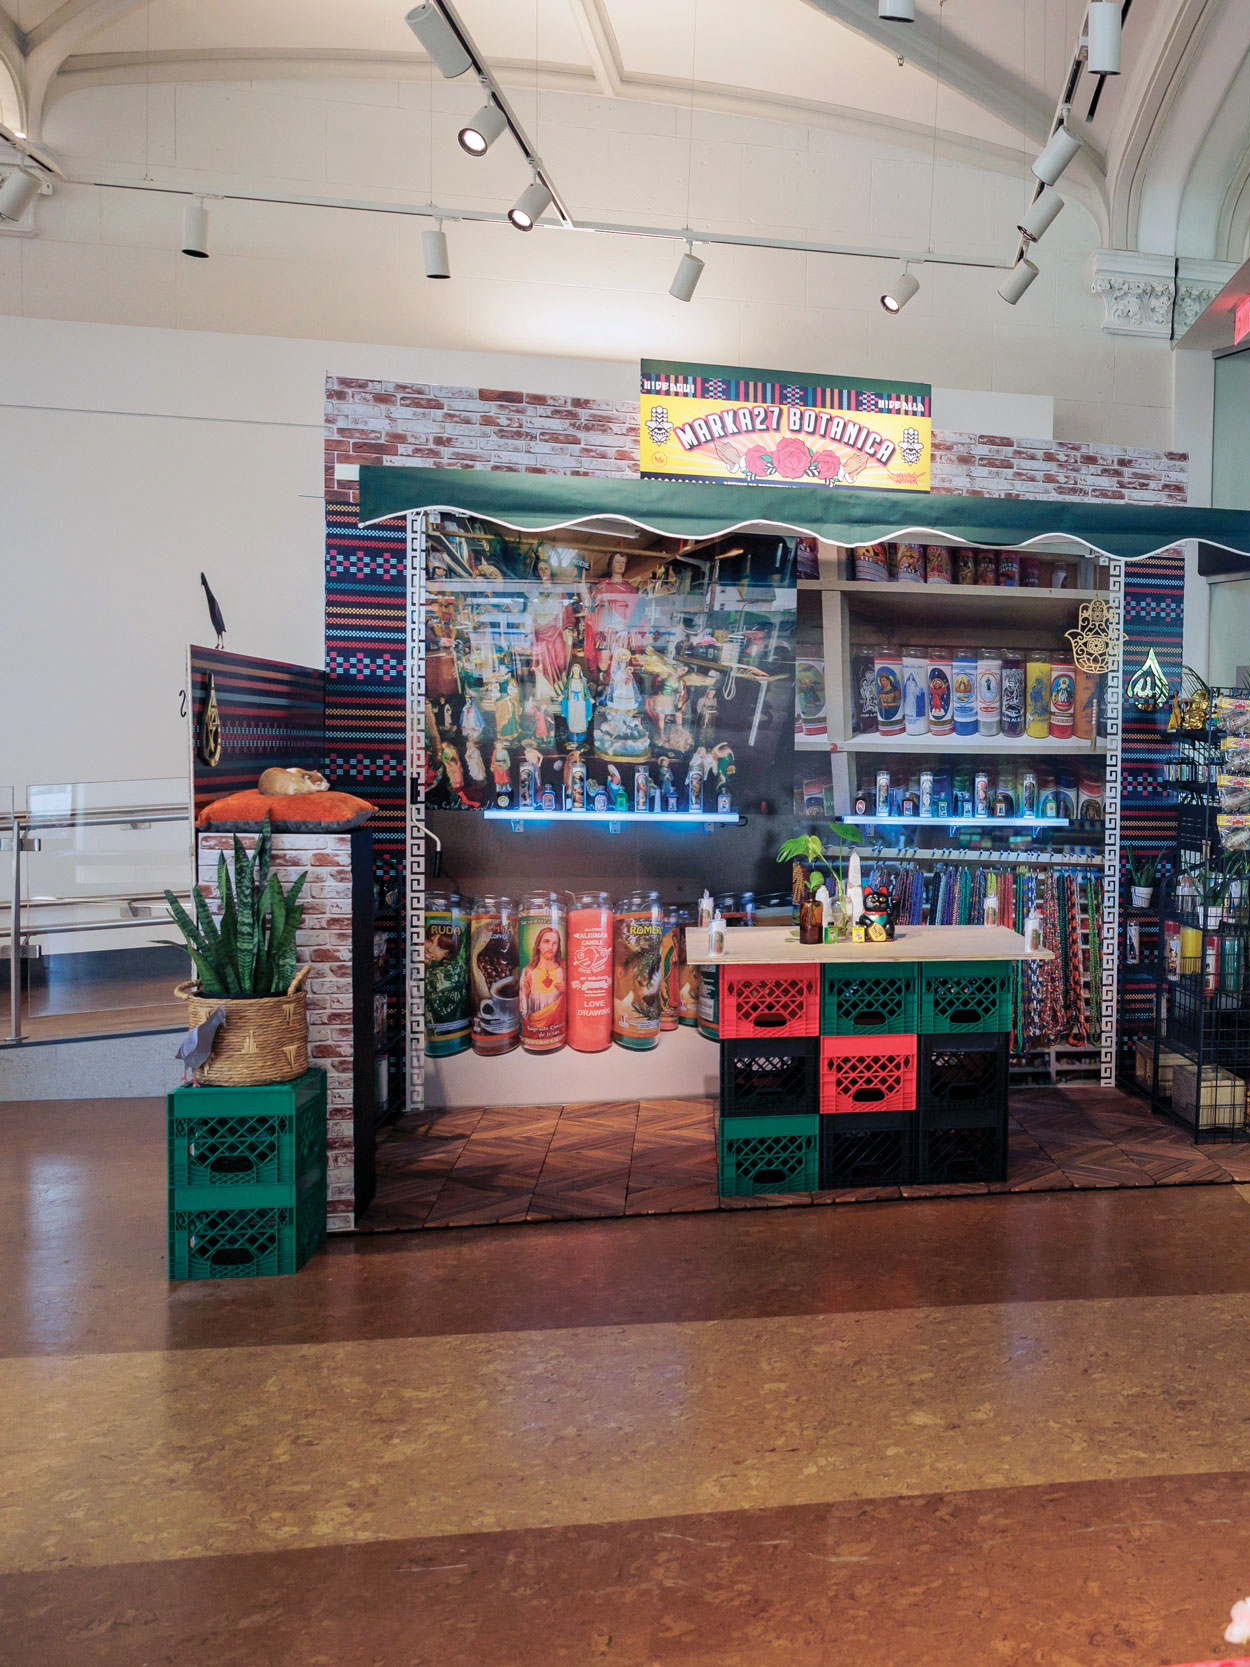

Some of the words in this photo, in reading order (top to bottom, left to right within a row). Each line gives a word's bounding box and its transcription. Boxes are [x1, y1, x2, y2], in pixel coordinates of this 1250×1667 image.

[675, 406, 781, 450] MARKA27
[789, 407, 896, 466] BOTANICA
[431, 925, 462, 936] RUDA
[629, 925, 663, 935] ROMER
[584, 1000, 605, 1008] LOVE
[577, 1007, 611, 1017] DRAWING
